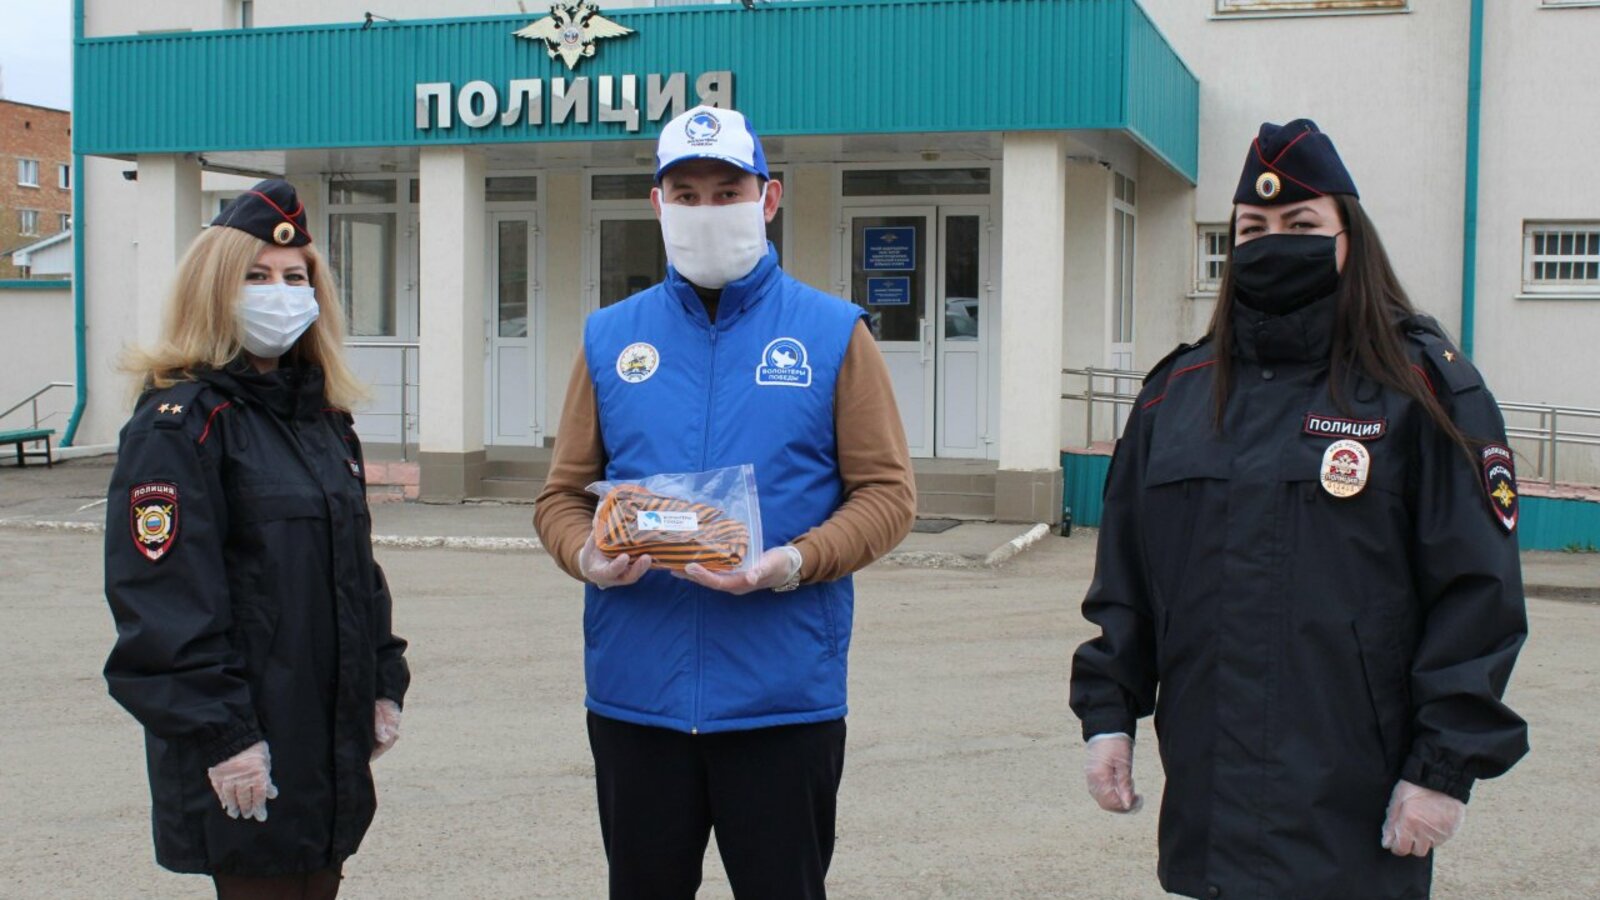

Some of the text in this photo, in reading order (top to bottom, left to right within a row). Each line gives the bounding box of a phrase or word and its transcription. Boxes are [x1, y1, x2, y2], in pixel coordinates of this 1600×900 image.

[416, 71, 733, 132] ПОЛИЦИЯ
[762, 368, 806, 376] ВОЛОНТЕРЫ
[1309, 418, 1382, 437] ПОЛИЦИЯ
[134, 486, 175, 498] ПОЛИЦИЯ
